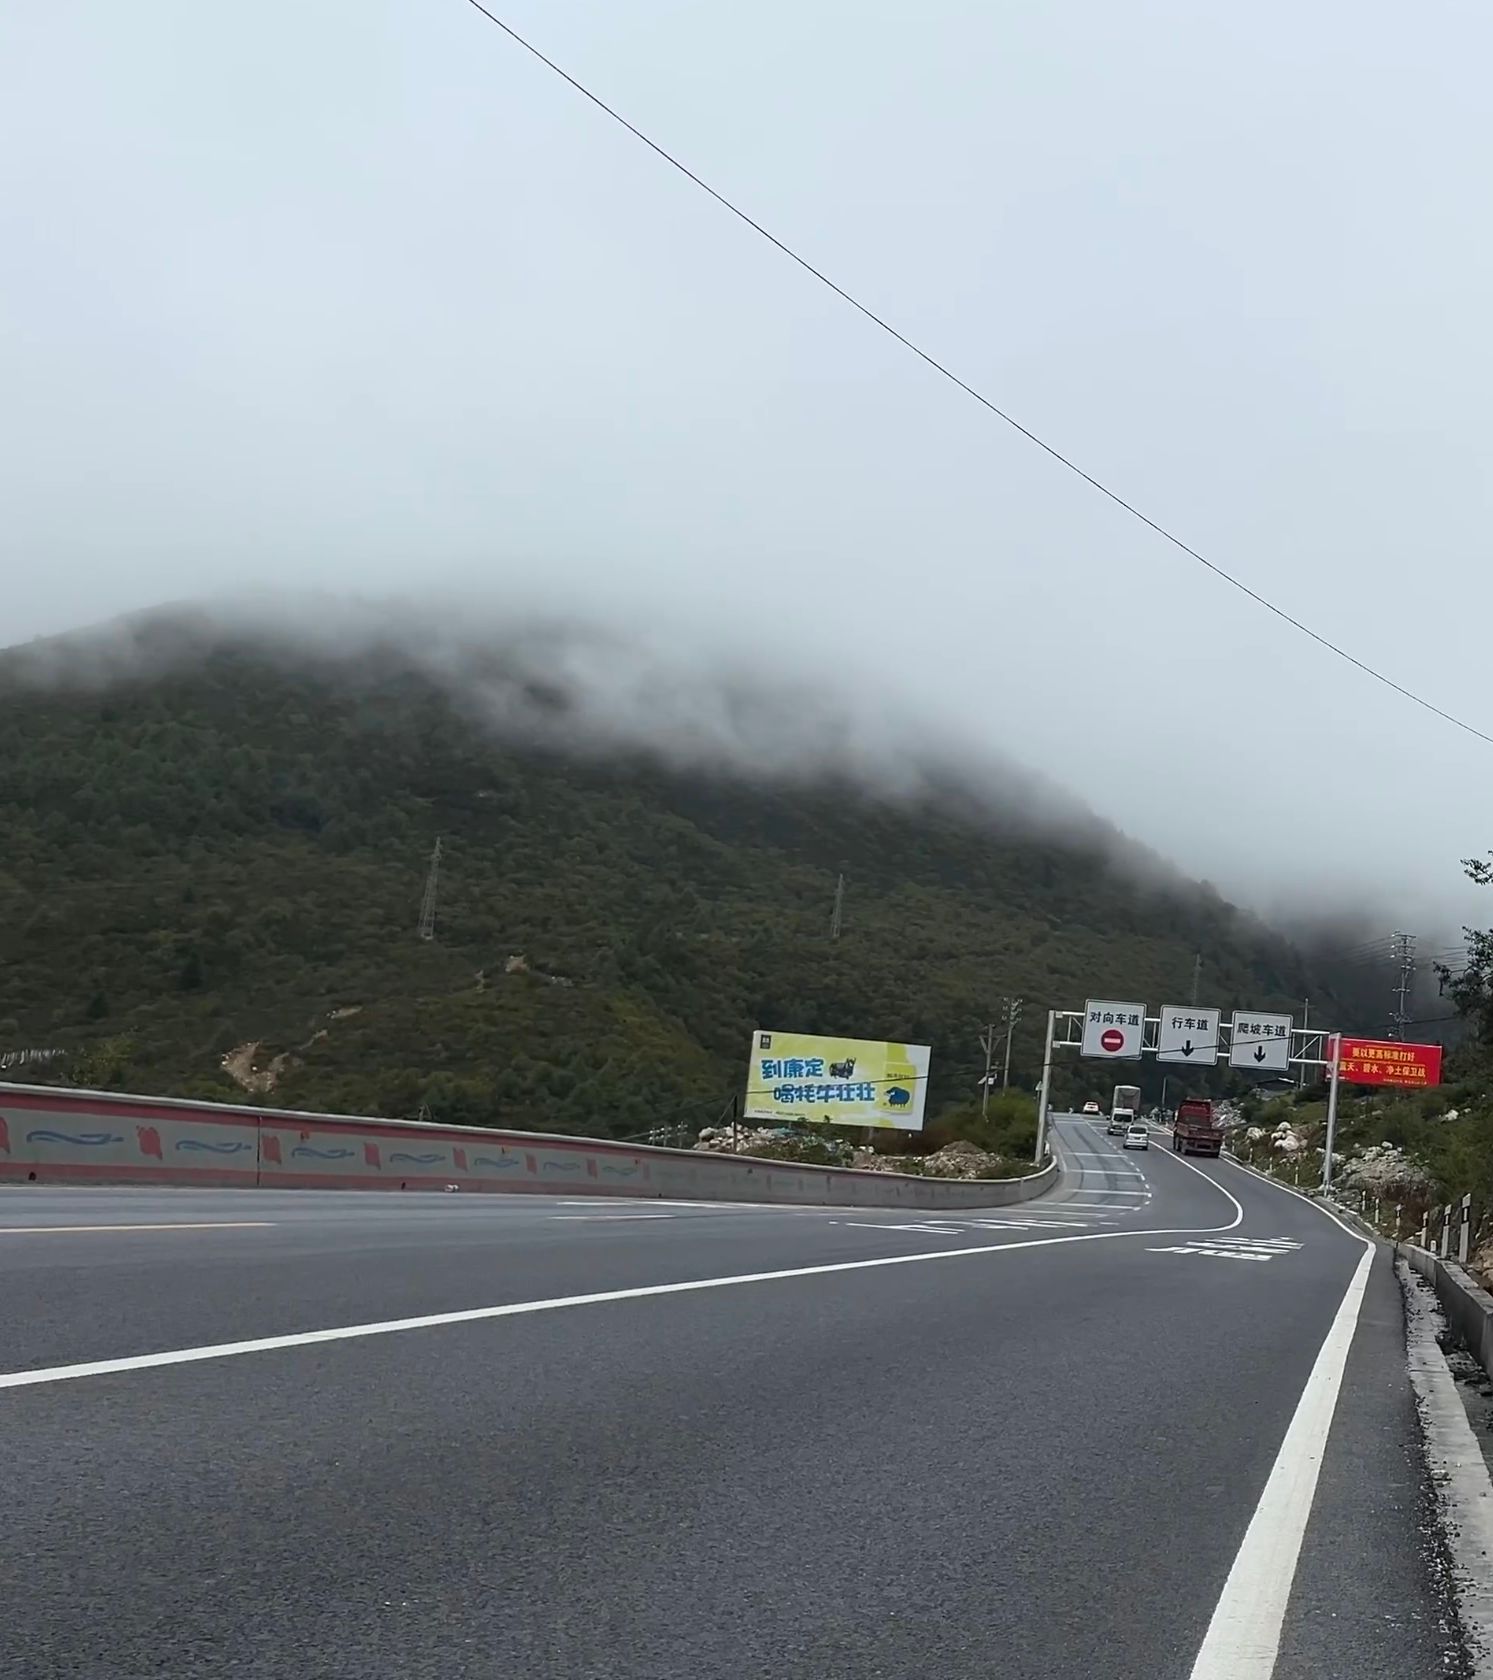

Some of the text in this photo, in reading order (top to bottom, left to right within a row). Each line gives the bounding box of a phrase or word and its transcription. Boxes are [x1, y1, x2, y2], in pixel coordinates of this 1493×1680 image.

[1089, 1011, 1140, 1027] 对向车道
[1171, 1016, 1210, 1031] 行车道
[1236, 1022, 1288, 1037] 爬坡车道
[761, 1058, 825, 1080] 到康定
